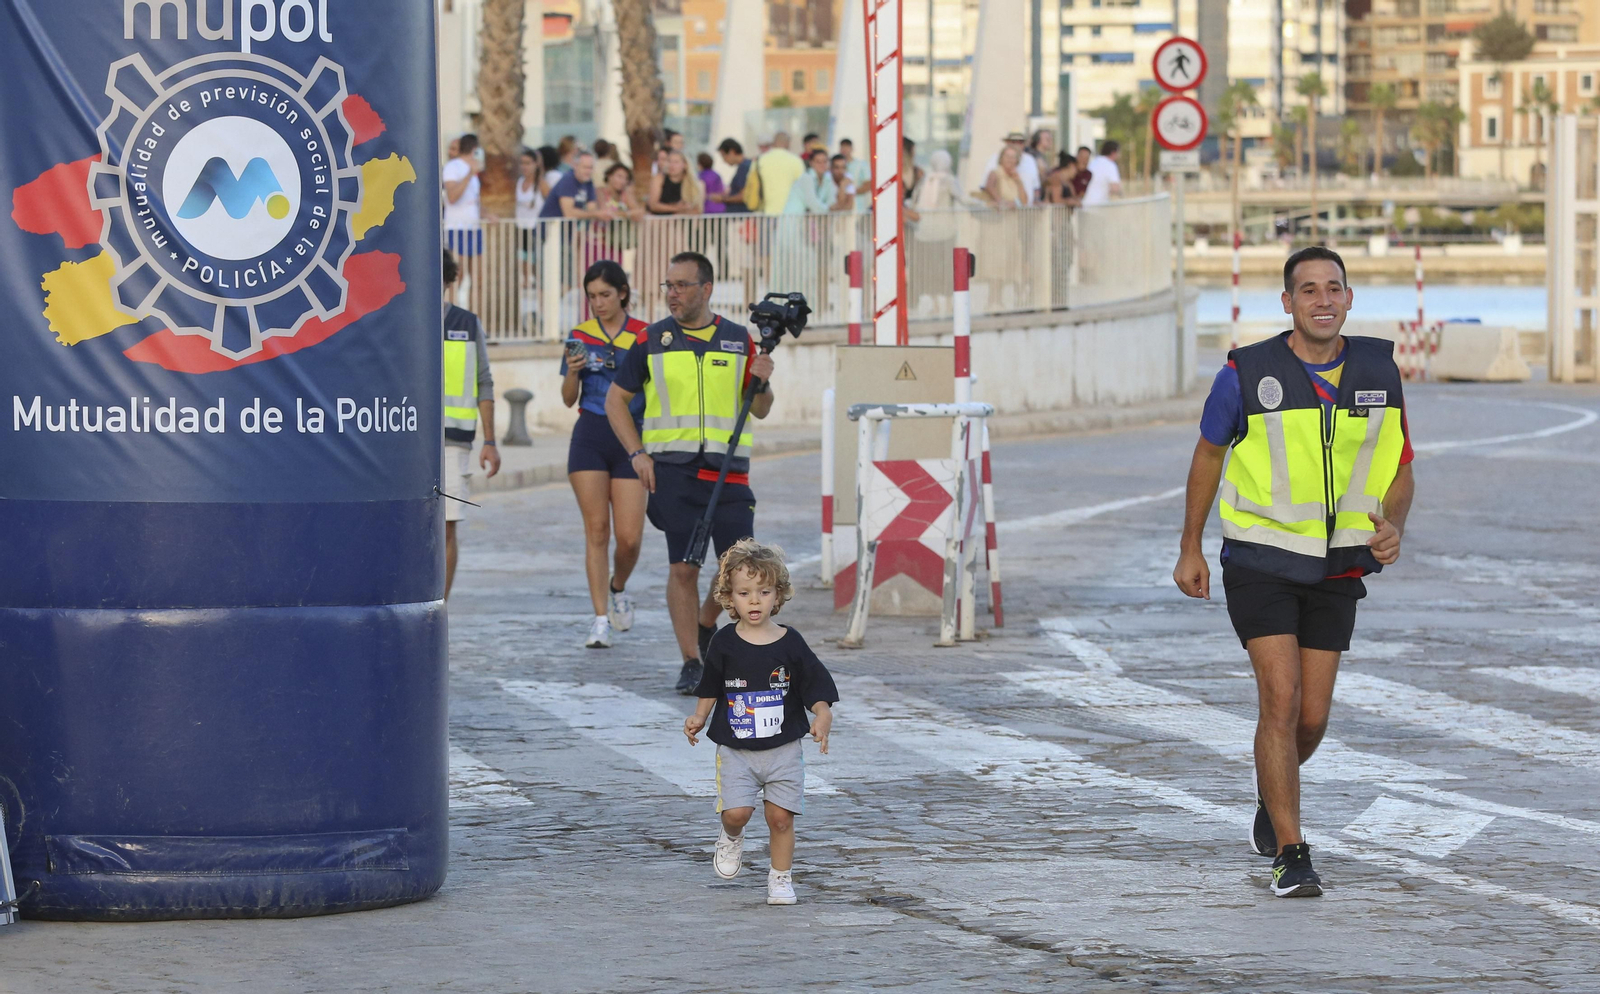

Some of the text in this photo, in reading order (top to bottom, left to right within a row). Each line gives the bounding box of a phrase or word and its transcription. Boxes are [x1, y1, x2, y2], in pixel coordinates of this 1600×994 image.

[123, 0, 333, 53] mupol
[131, 85, 329, 256] mutualidad de previsión social de la
[181, 256, 285, 289] POLICÍA
[13, 395, 418, 434] Mutualidad de la Policía
[756, 694, 782, 702] DORSAL
[763, 717, 780, 727] 119
